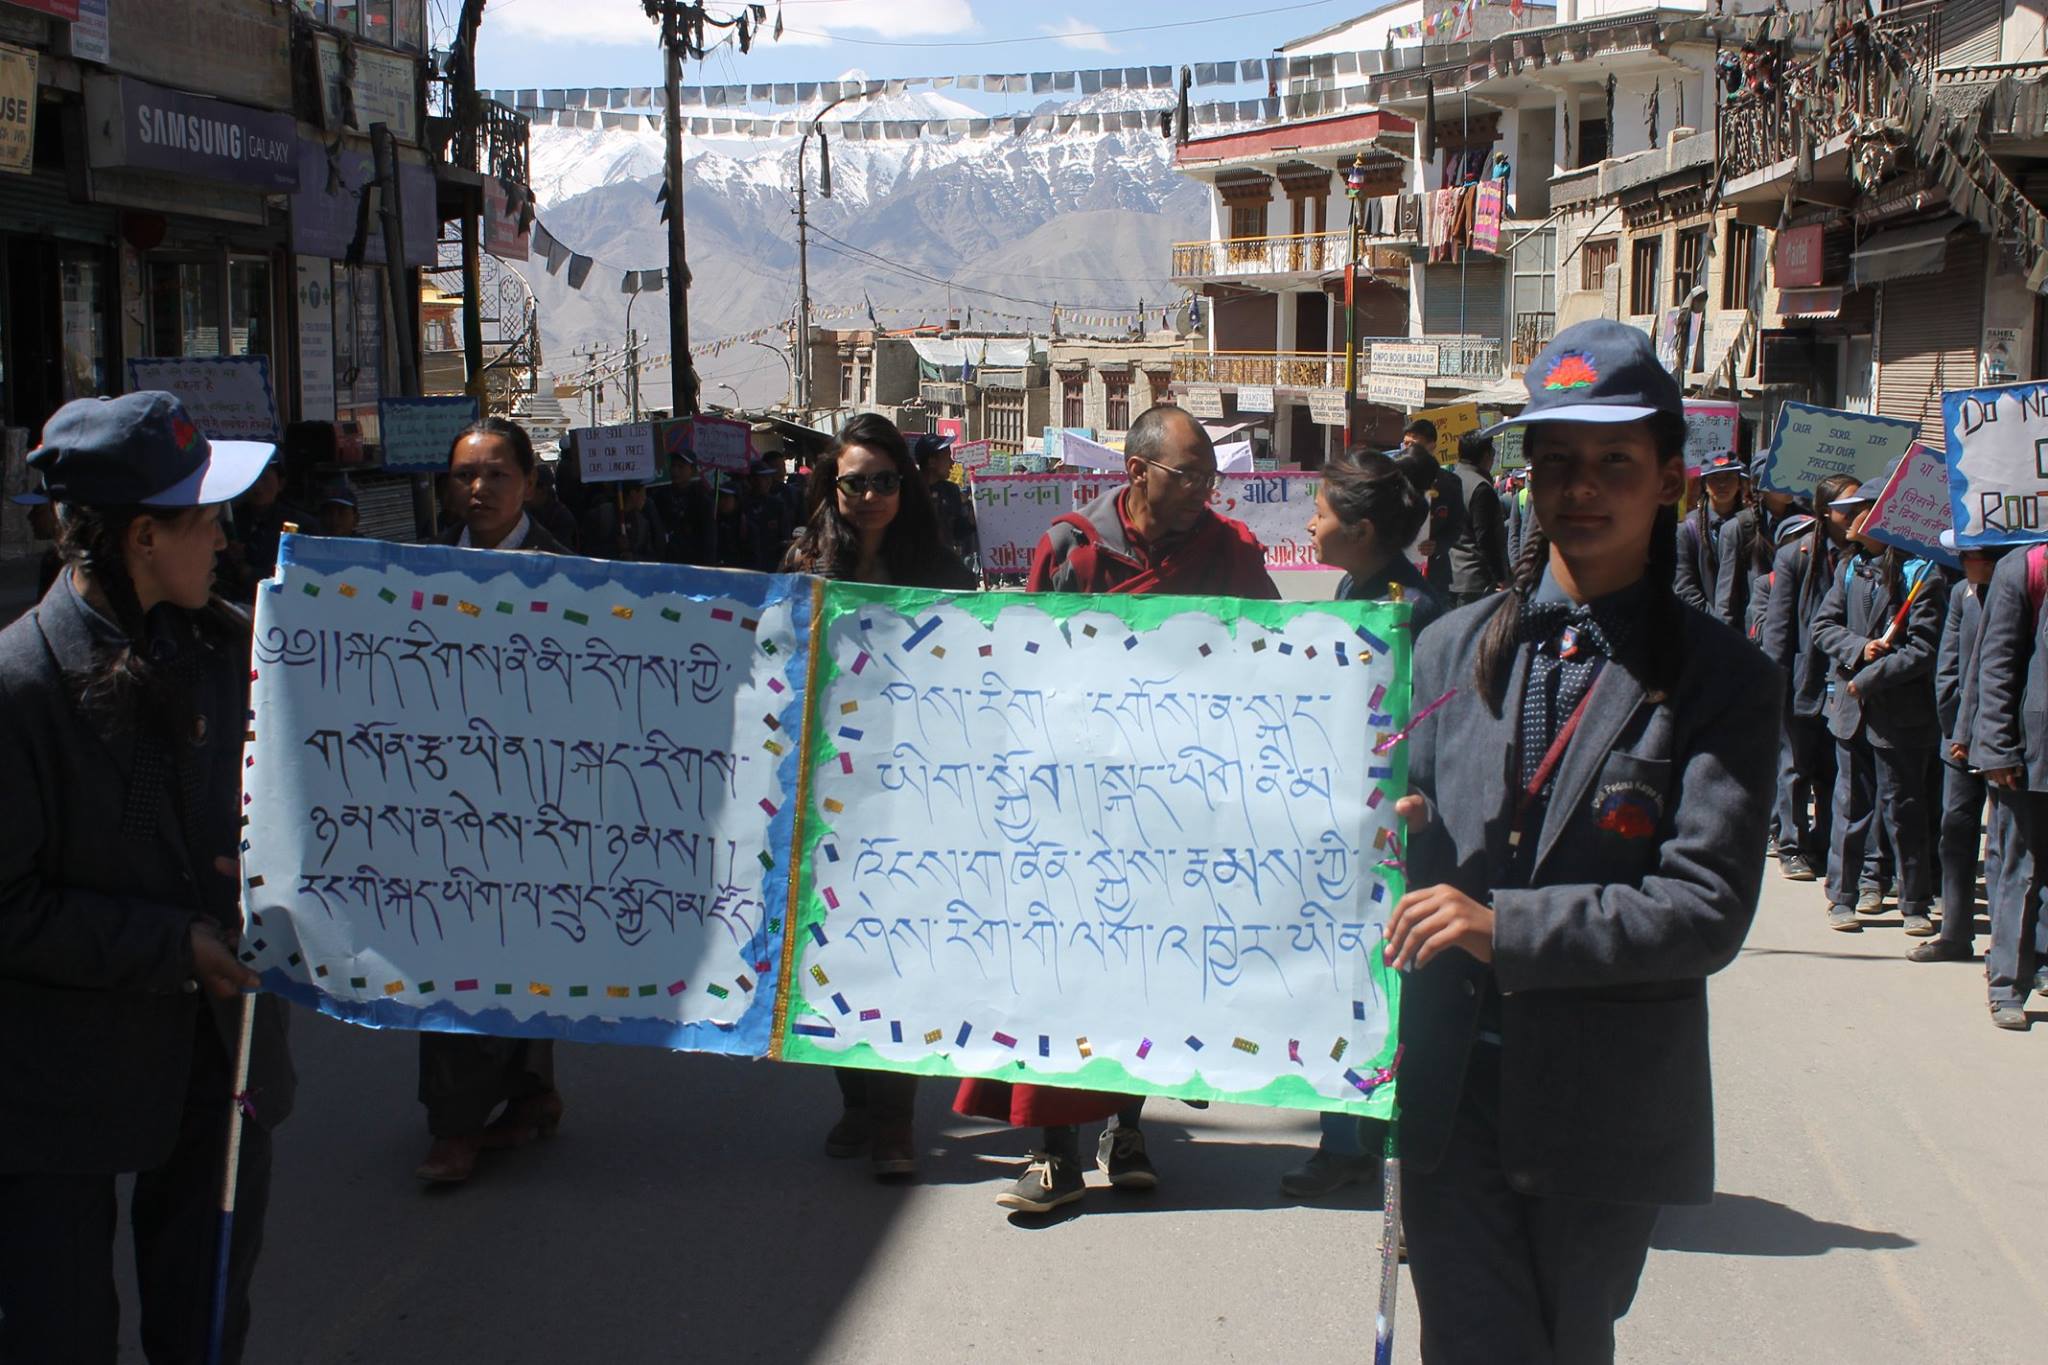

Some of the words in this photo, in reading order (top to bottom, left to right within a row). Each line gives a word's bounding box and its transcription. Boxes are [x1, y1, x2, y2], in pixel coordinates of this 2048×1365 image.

[138, 104, 242, 160] SAMSUNG
[248, 135, 289, 165] GALAXY
[1389, 352, 1405, 363] BOOK
[1407, 352, 1435, 364] BAZAAR
[1792, 421, 1812, 435] OUR
[1815, 442, 1835, 455] IN
[1835, 446, 1856, 459] OUR
